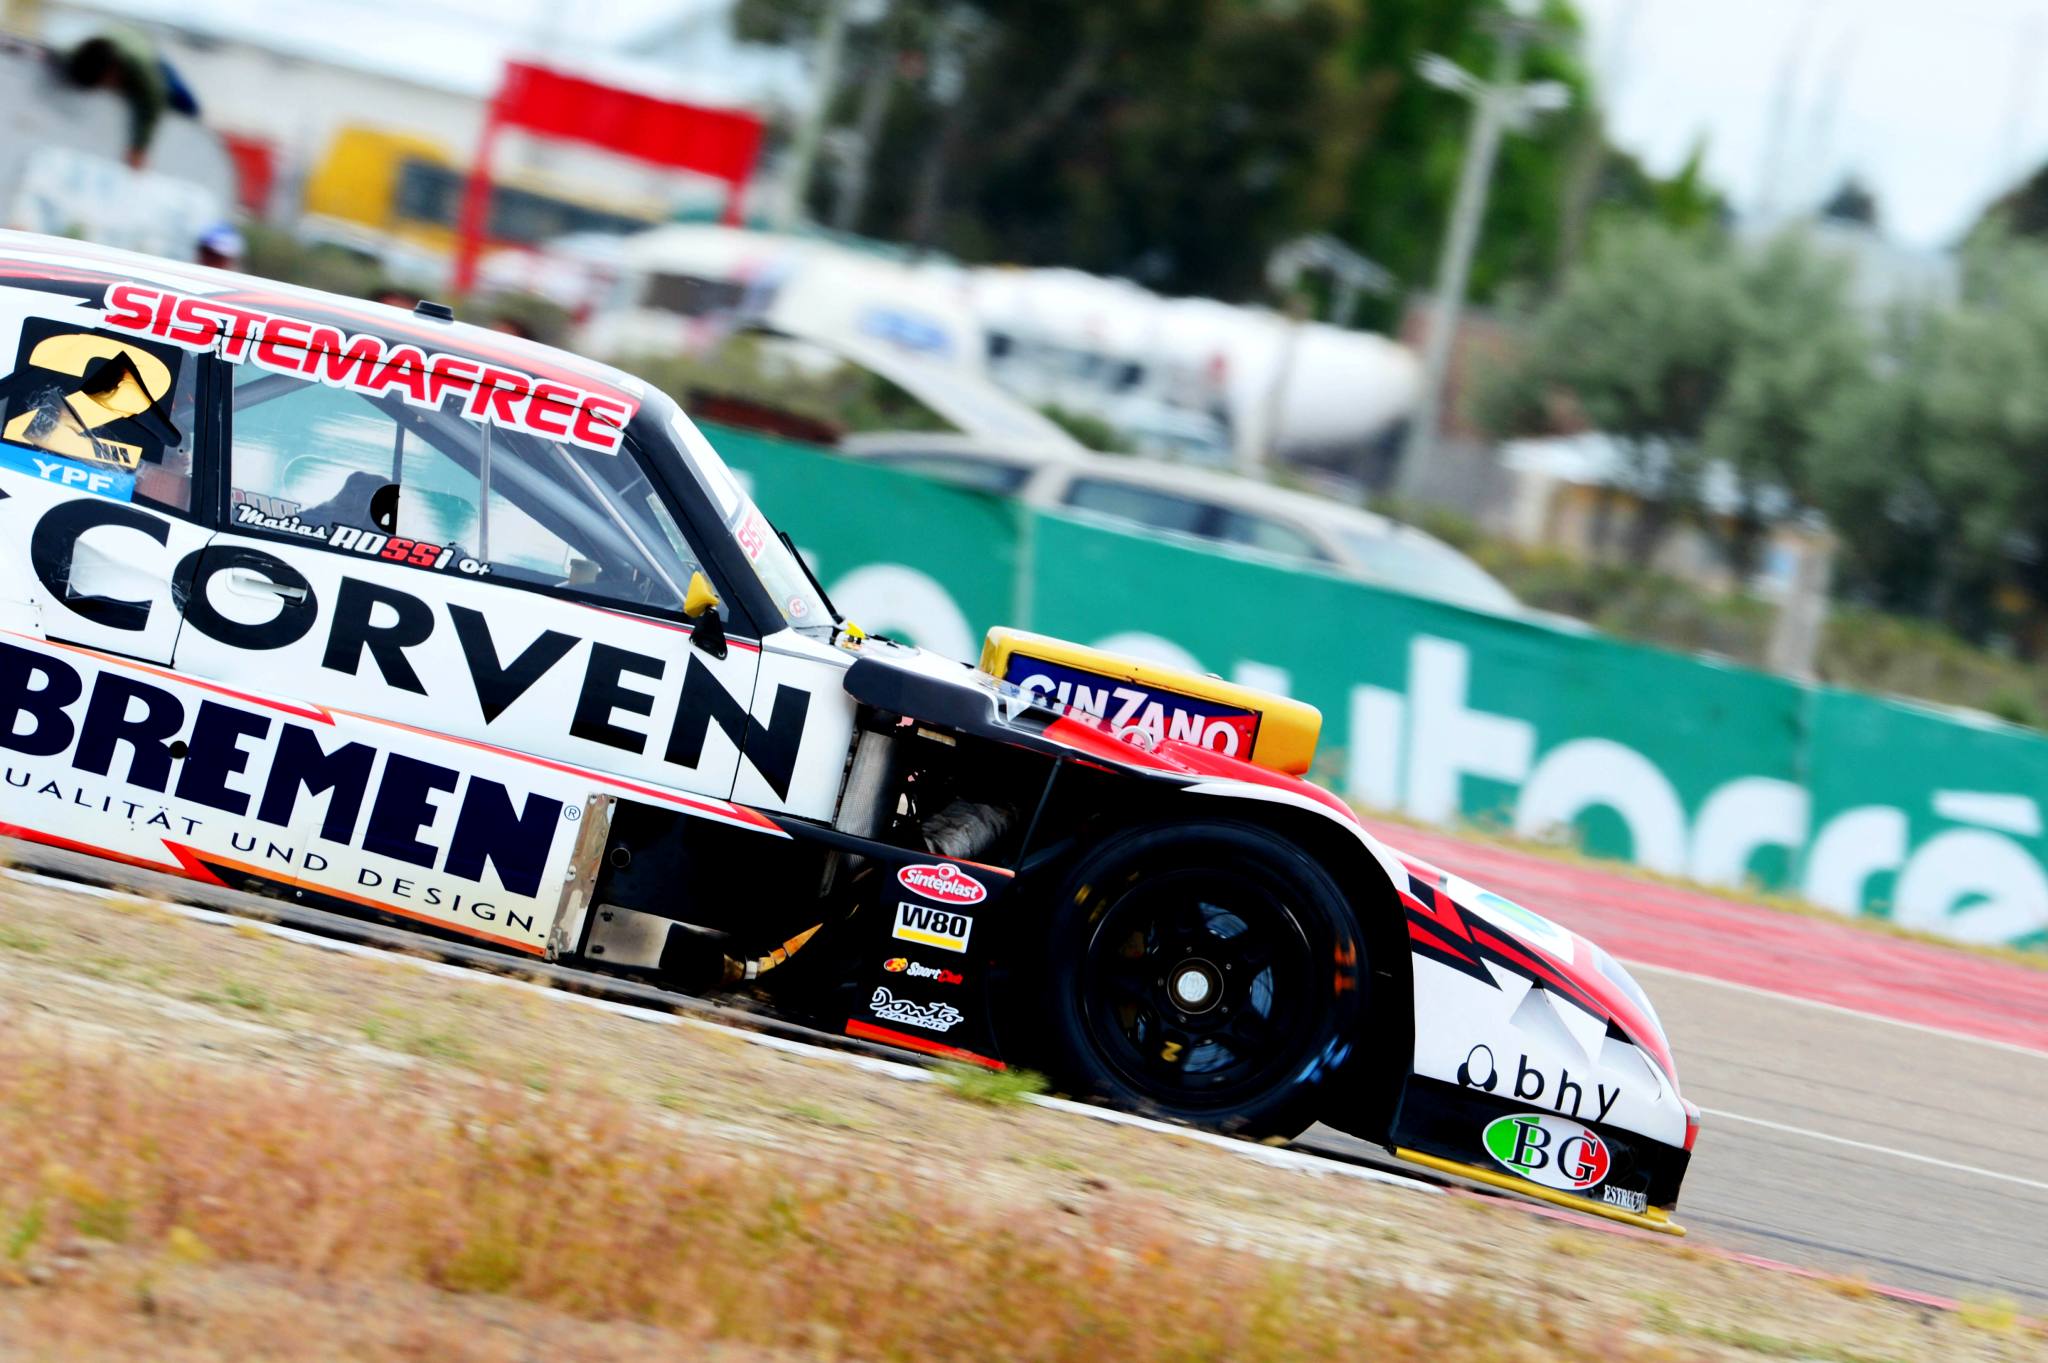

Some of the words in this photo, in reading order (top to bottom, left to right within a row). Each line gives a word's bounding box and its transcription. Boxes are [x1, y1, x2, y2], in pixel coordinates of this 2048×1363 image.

[104, 285, 632, 449] SISTEMAFREE
[3, 333, 172, 468] 2
[32, 457, 114, 492] YPF
[237, 505, 328, 540] Matias
[31, 498, 812, 804] CORVEN
[1017, 674, 1240, 758] CINZANO
[230, 831, 329, 872] UND
[904, 869, 980, 899] Sinteplast
[902, 904, 967, 938] W80
[1513, 1054, 1621, 1122] bhy
[1507, 1120, 1598, 1184] BG
